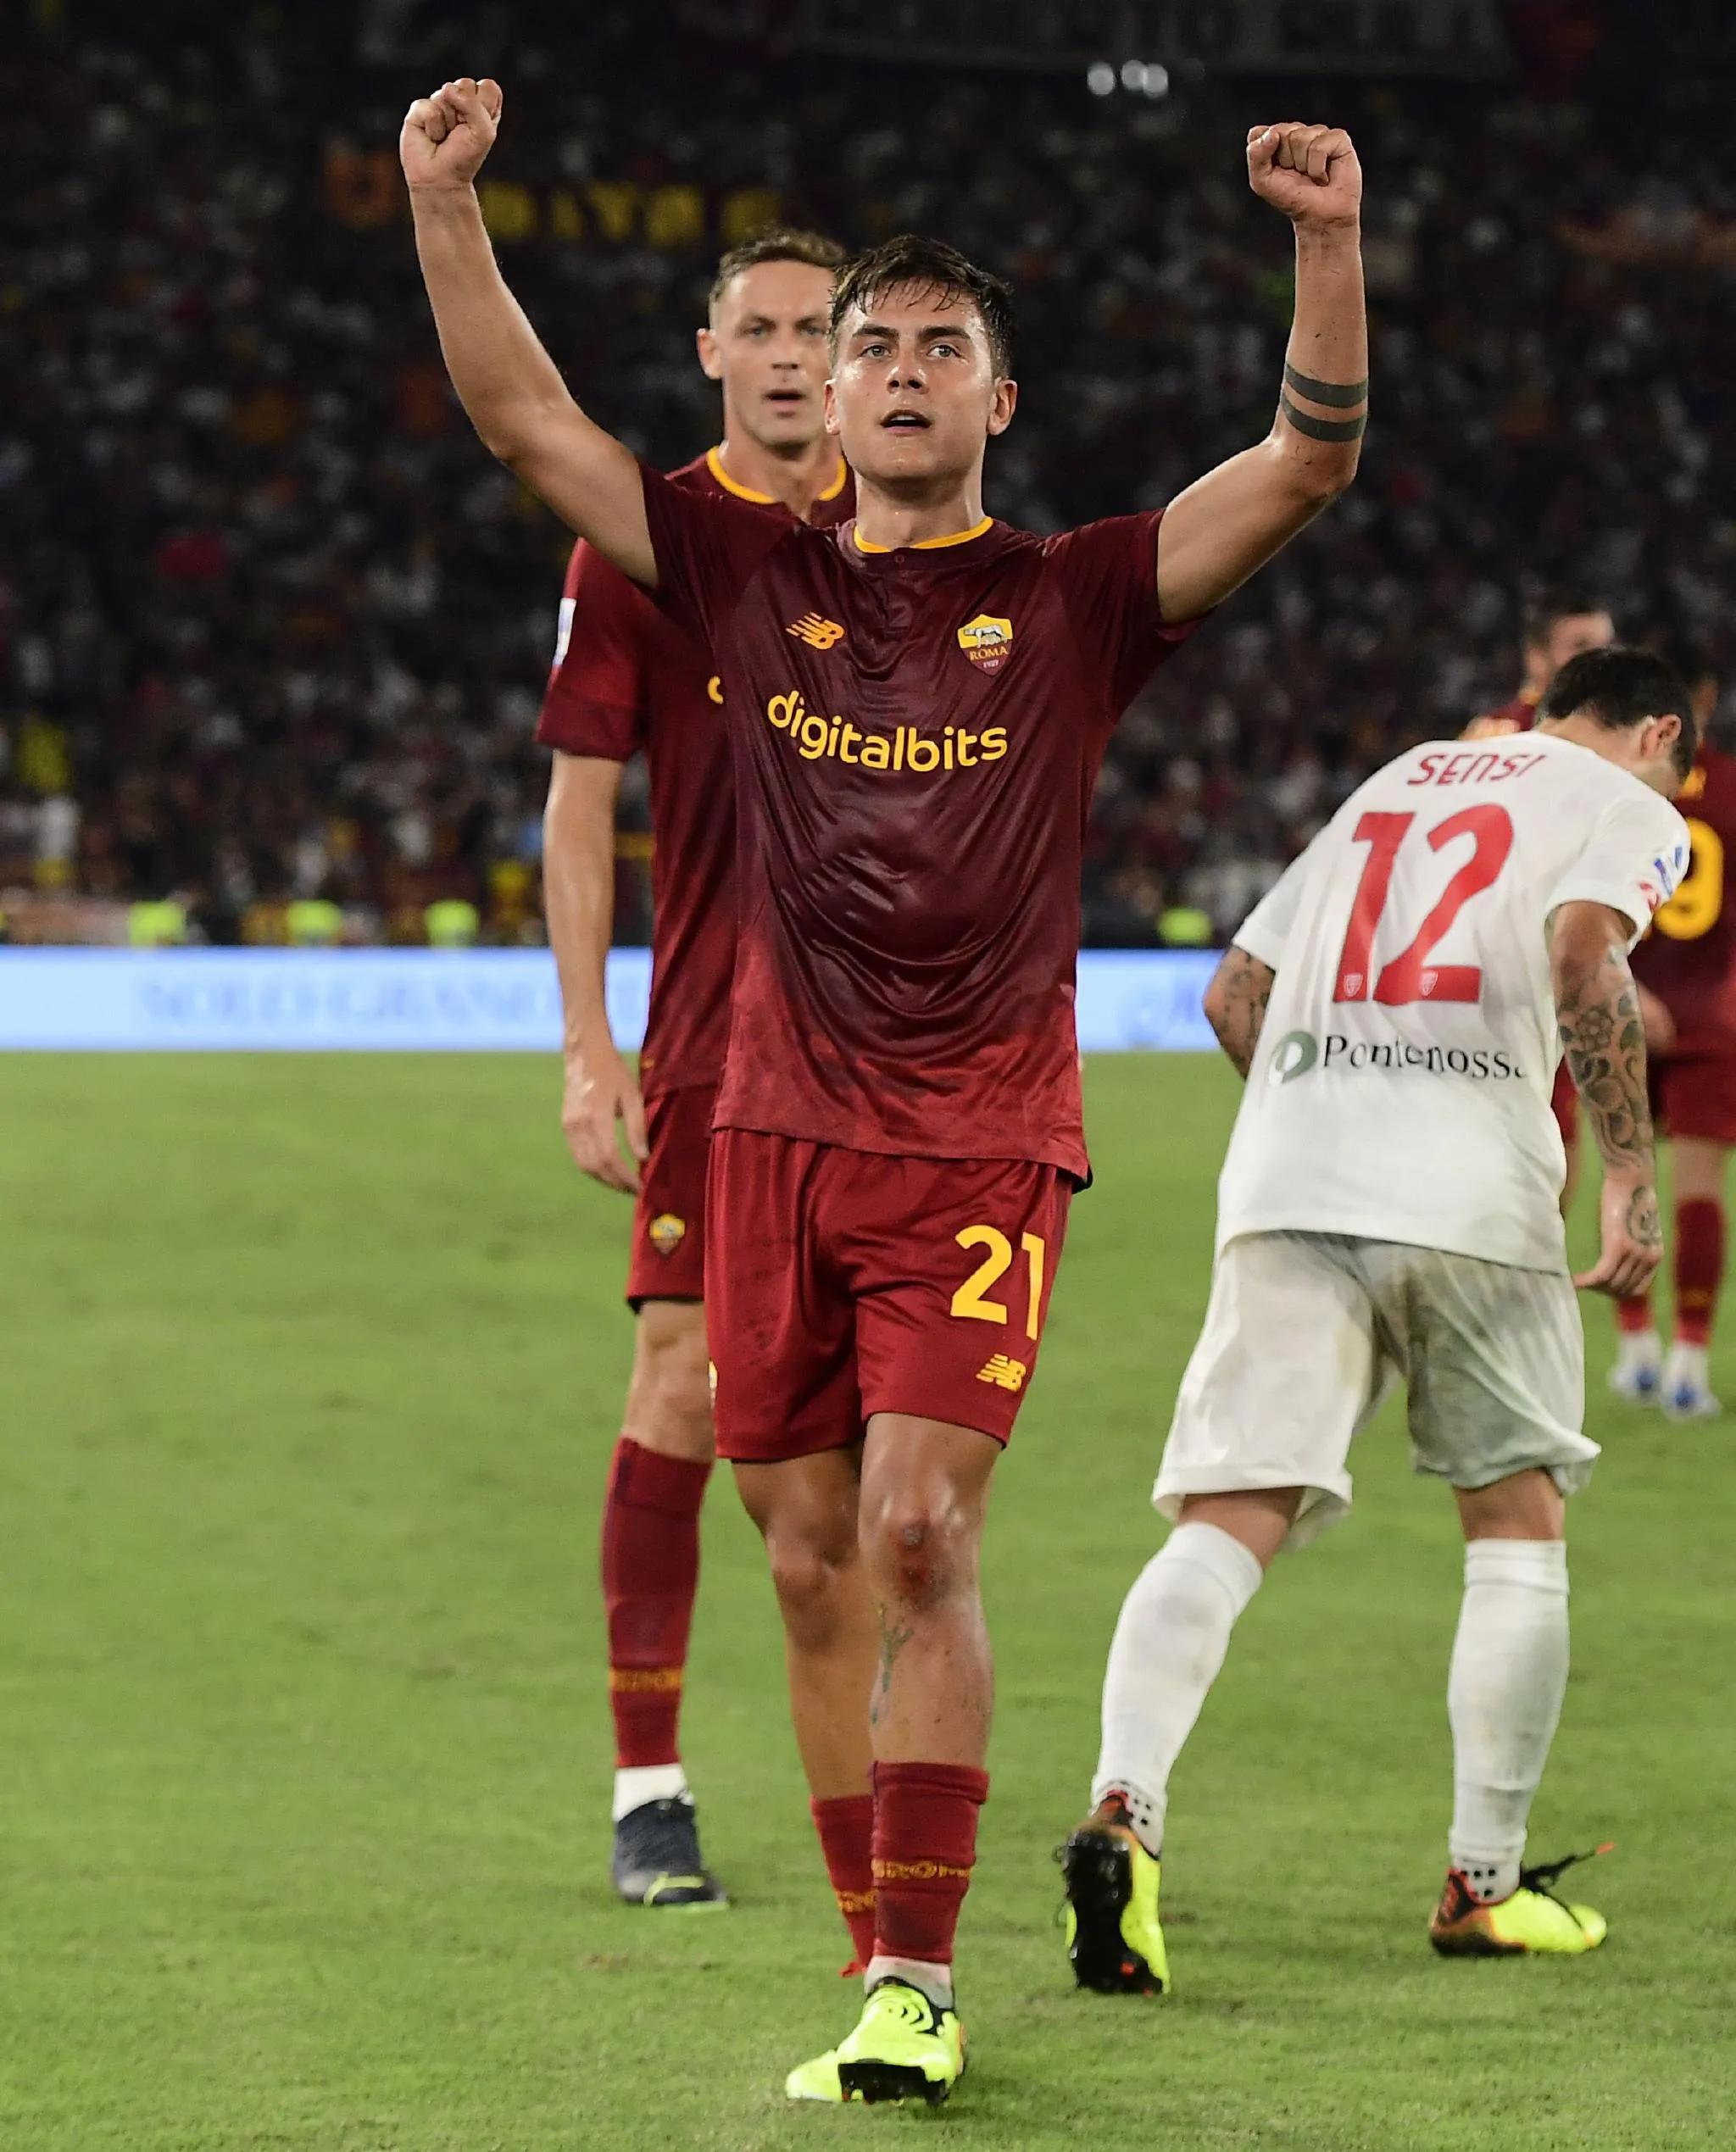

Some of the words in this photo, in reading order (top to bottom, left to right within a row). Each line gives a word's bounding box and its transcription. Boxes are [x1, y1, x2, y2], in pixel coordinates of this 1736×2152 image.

[970, 646, 1010, 661] ROMA
[767, 690, 1008, 772] digitalbits
[1407, 754, 1547, 786] SENSI
[1333, 804, 1515, 1006] 12
[950, 1224, 1045, 1341] 21
